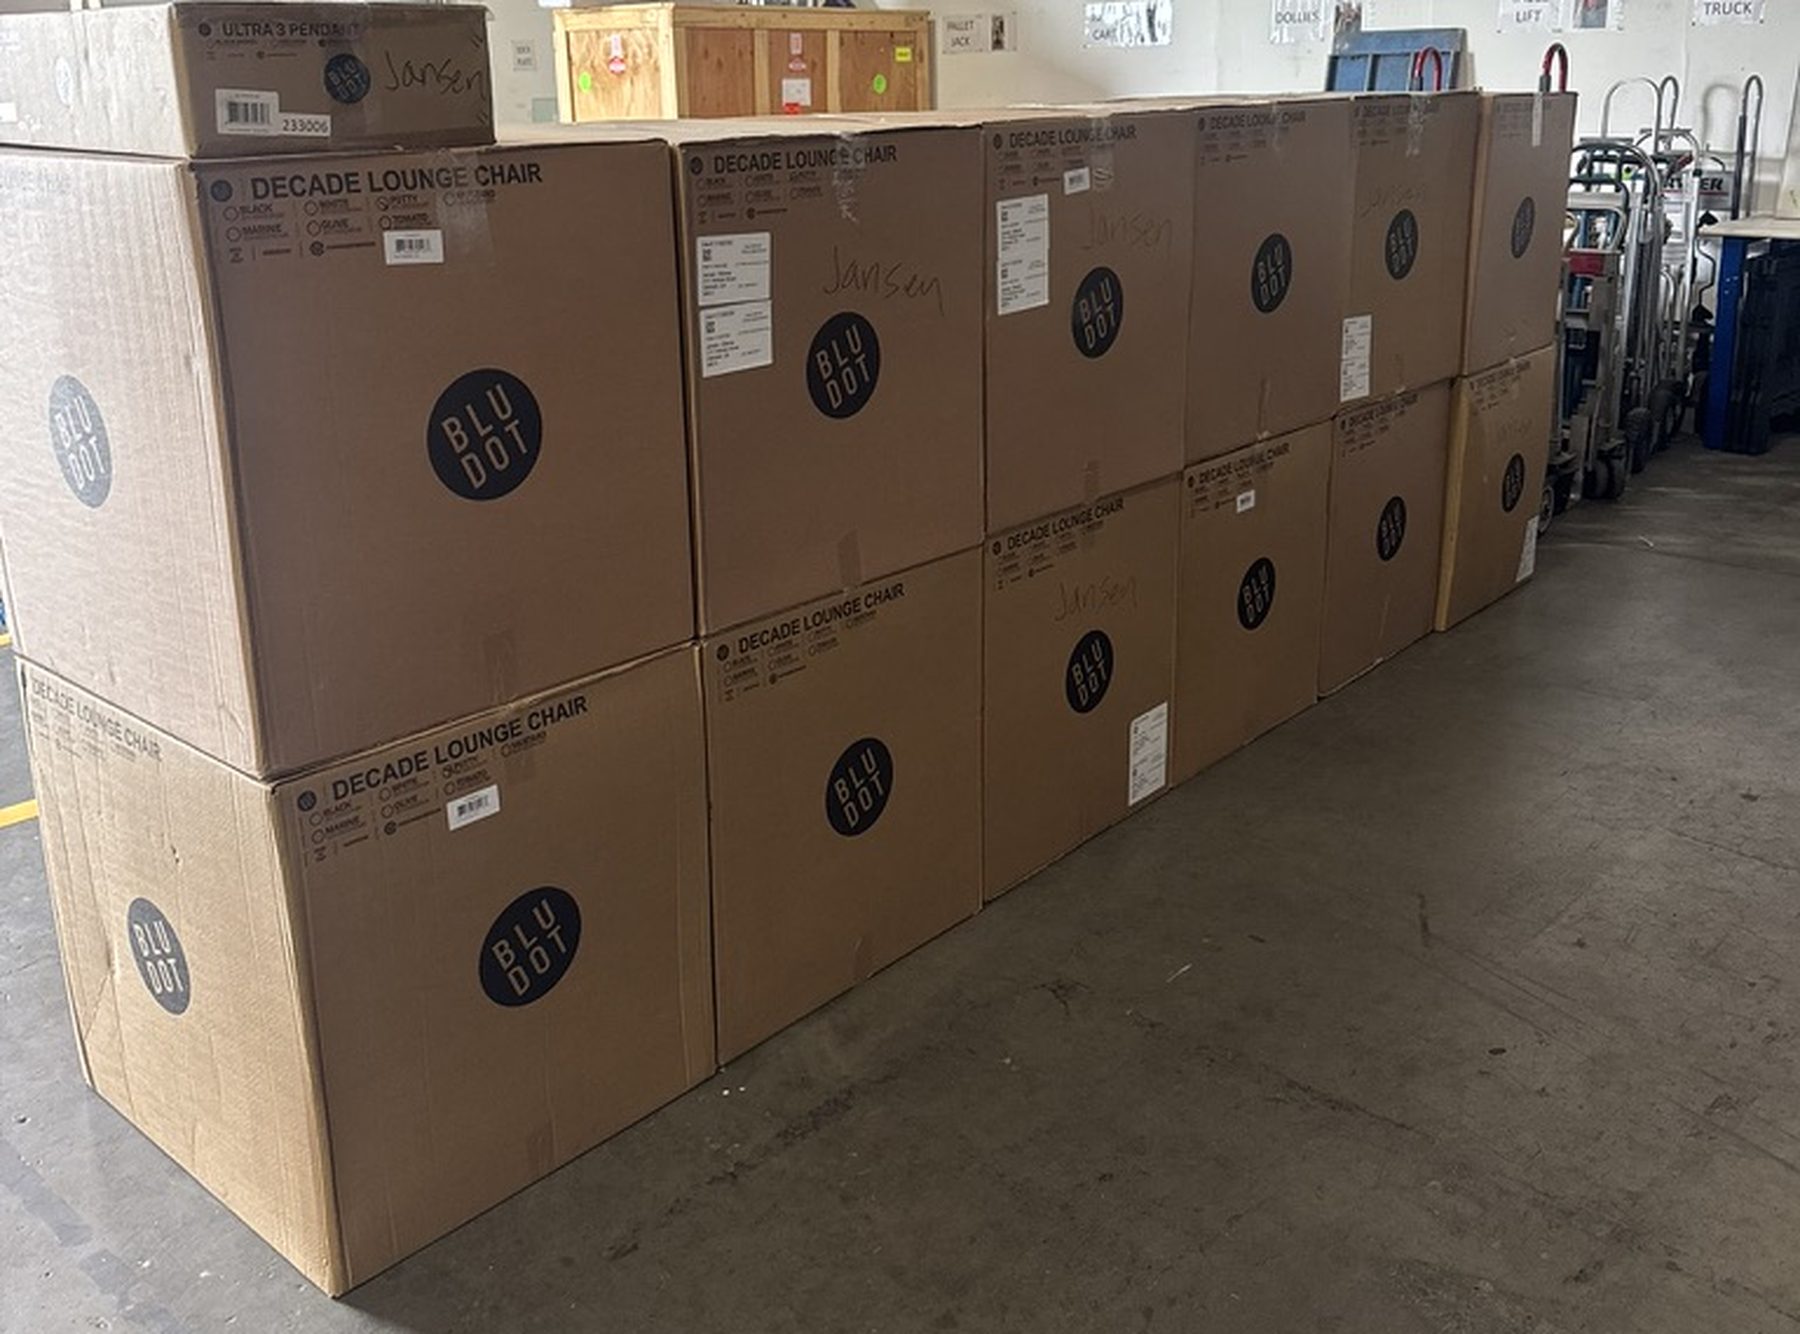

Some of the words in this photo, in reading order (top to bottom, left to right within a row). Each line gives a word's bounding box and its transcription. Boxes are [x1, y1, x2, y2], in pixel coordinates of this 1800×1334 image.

[222, 21, 273, 37] ULTRA
[275, 21, 286, 36] 3
[1515, 9, 1541, 22] LIFT
[1704, 1, 1751, 15] TRUCK
[384, 50, 486, 100] Jansen
[281, 117, 329, 133] 233006
[1009, 130, 1057, 149] DECADE
[252, 172, 361, 200] DECADE
[370, 166, 469, 192] LOUNGE
[474, 162, 543, 186] CHAIR
[714, 151, 781, 175] DECADE
[785, 147, 850, 169] LOUNGE
[854, 144, 898, 165] CHAIR
[240, 203, 275, 214] BLACK
[242, 224, 283, 236] MARINE
[1080, 208, 1174, 258] Jansen
[823, 246, 944, 317] Jansen
[1257, 243, 1283, 284] BLU
[1260, 264, 1285, 306] DOT
[1079, 276, 1112, 324] BLU
[1084, 302, 1115, 349] DOT
[816, 323, 862, 380] BLU
[826, 353, 870, 409] DOT
[55, 394, 92, 449] BLU
[441, 383, 513, 454] BLU
[68, 435, 105, 490] DOT
[461, 419, 528, 490] DOT
[1007, 521, 1050, 551] DECADE
[1054, 574, 1138, 621] Jansen
[1242, 565, 1269, 605] BLU
[1247, 583, 1269, 623] DOT
[738, 618, 802, 655] DECADE
[803, 596, 862, 631] LOUNGE
[864, 582, 905, 609] CHAIR
[1071, 639, 1103, 686] BLU
[1077, 659, 1107, 706] DOT
[332, 751, 429, 801] DECADE
[435, 715, 523, 765] LOUNGE
[528, 694, 589, 731] CHAIR
[834, 747, 877, 805] BLU
[843, 770, 884, 829] DOT
[133, 920, 171, 957] BLU
[492, 898, 557, 972] BLU
[146, 958, 184, 994] DOT
[507, 924, 567, 997] DOT
